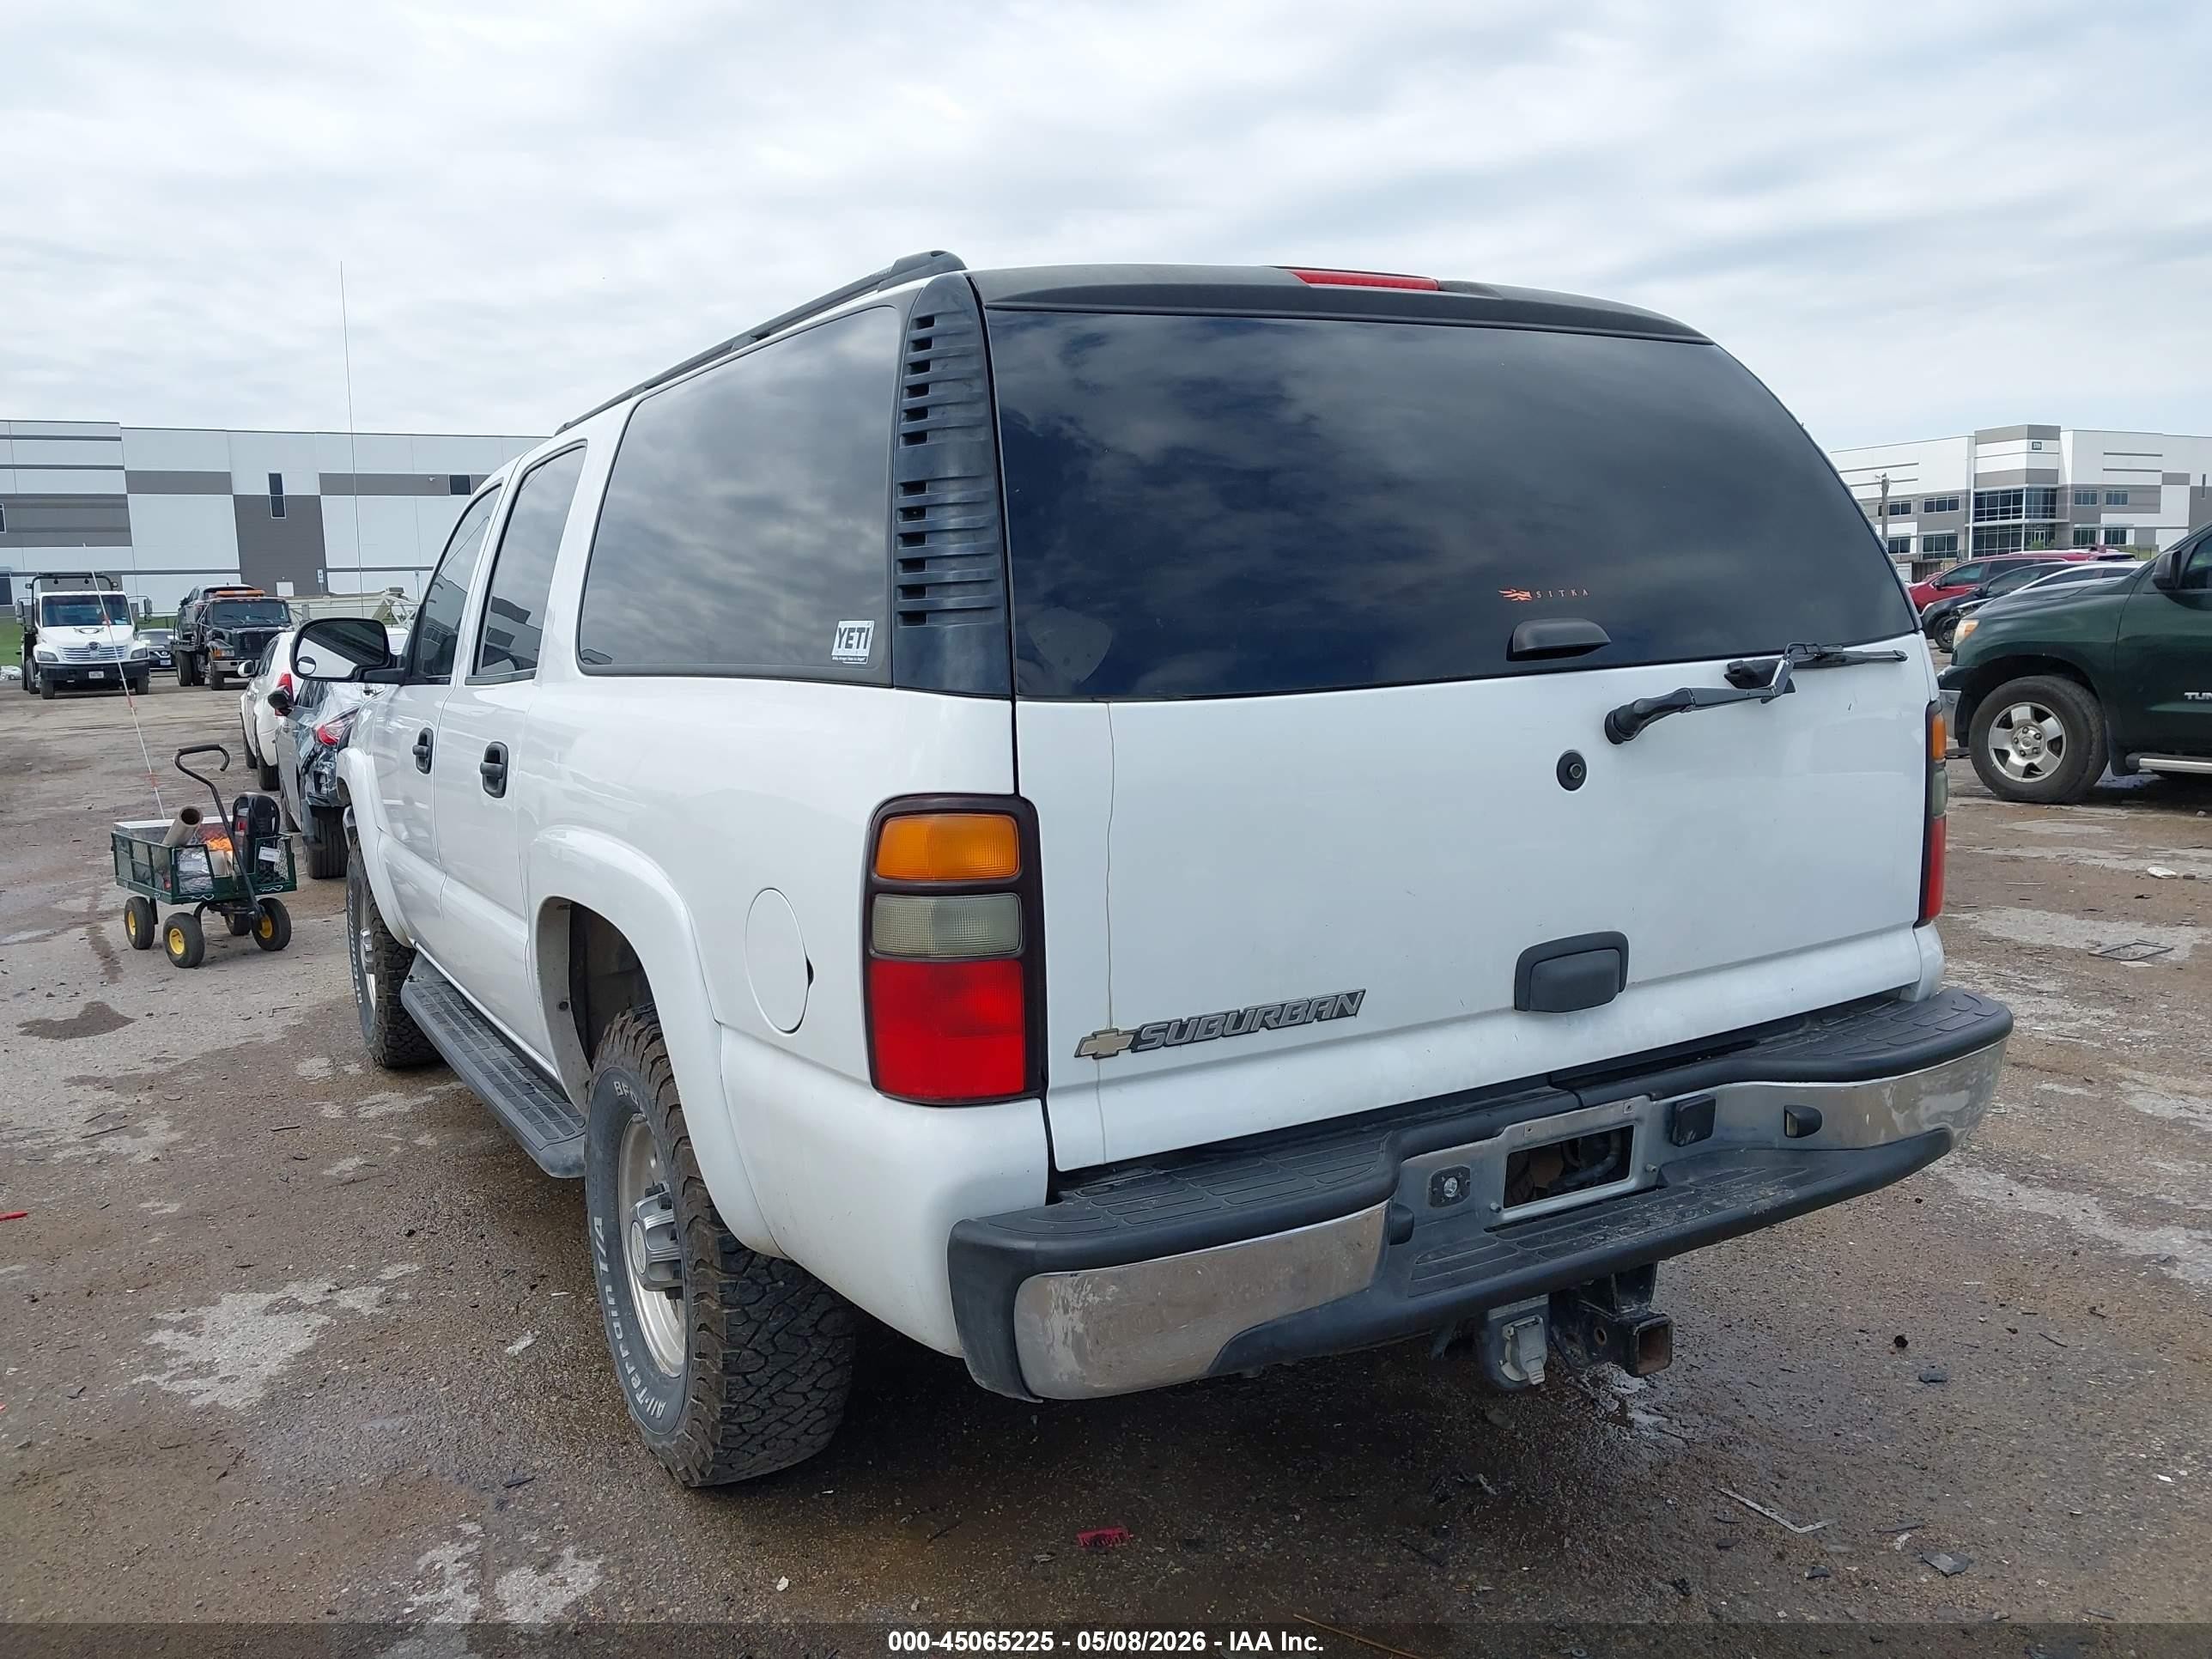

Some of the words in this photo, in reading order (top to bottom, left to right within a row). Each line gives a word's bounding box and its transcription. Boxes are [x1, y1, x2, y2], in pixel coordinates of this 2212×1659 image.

[1535, 588, 1589, 599] SITKA
[837, 627, 871, 649] YETI
[1133, 990, 1365, 1052] SUBURBAN
